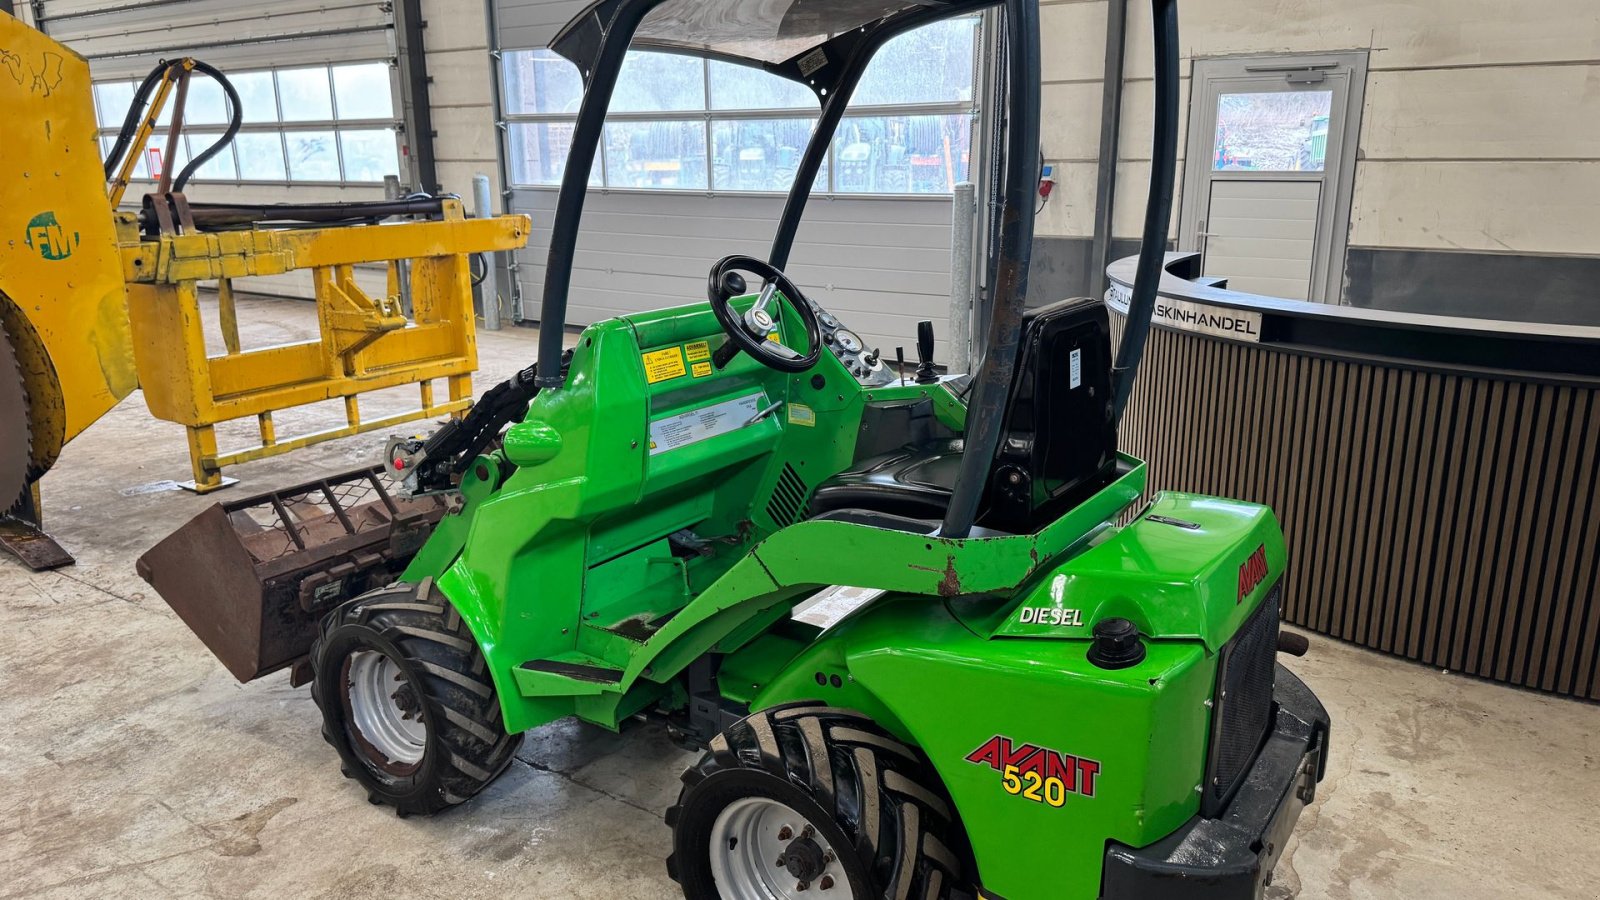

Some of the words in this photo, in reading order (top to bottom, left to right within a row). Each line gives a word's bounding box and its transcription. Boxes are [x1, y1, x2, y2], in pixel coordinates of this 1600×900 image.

[1237, 542, 1268, 605] AVANT
[1019, 606, 1084, 627] DIESEL
[963, 734, 1101, 797] AVANT
[1002, 764, 1066, 808] 520
